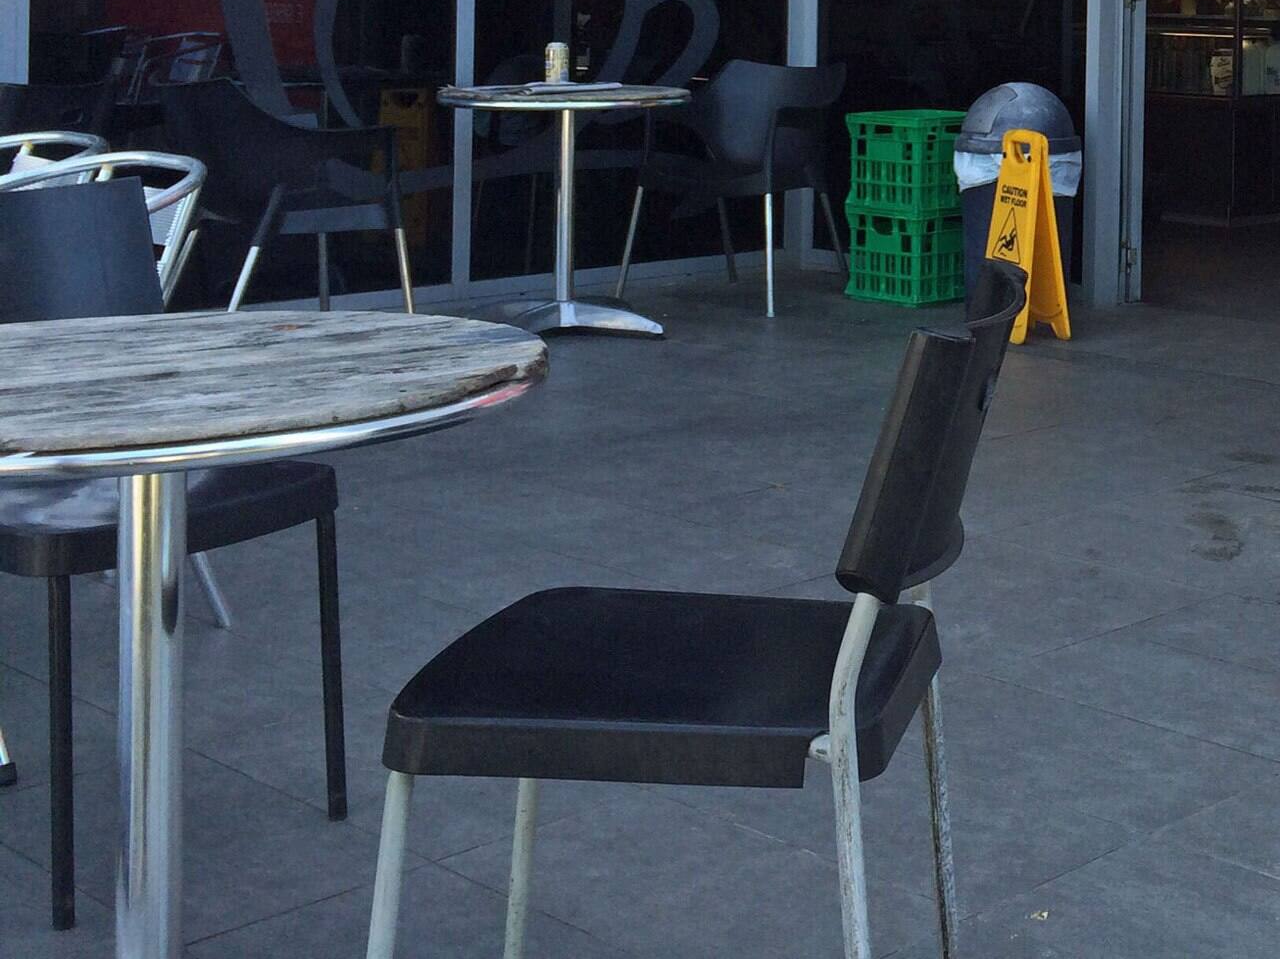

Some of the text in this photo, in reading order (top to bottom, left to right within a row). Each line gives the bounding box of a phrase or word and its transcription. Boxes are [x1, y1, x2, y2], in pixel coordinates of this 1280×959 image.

[1001, 185, 1028, 198] CAUTION
[1000, 195, 1027, 208] WET FLOOR
